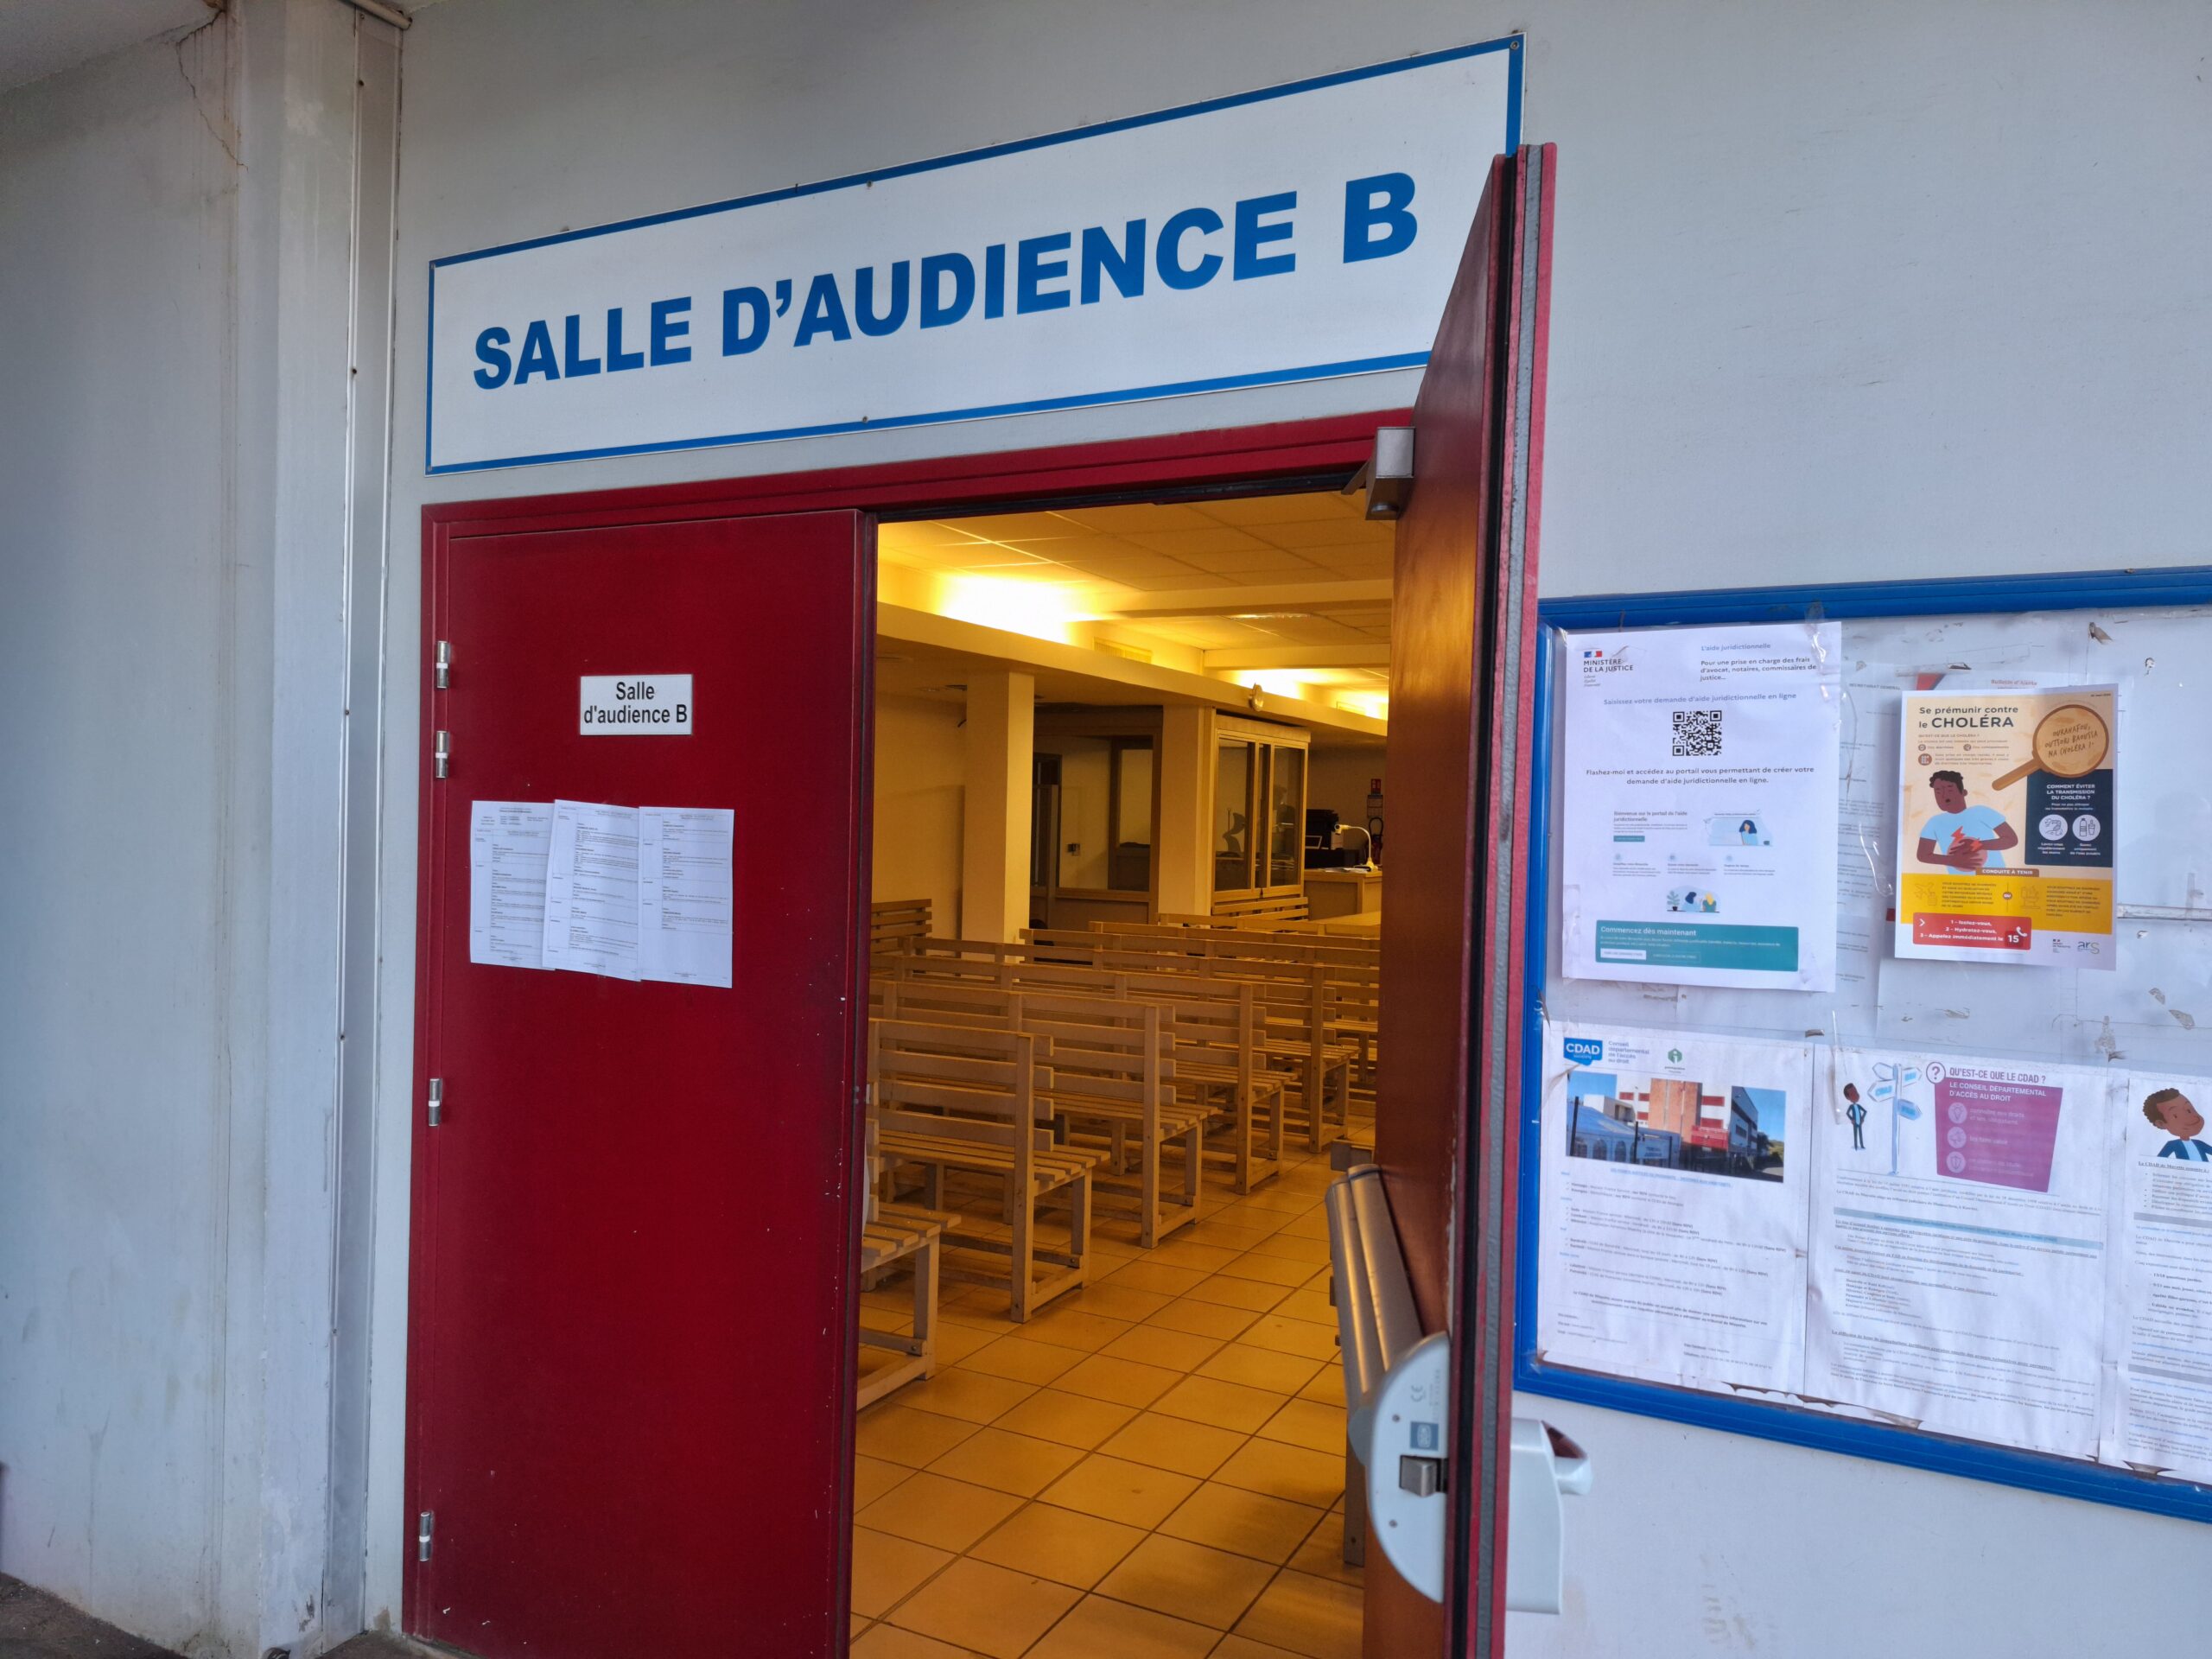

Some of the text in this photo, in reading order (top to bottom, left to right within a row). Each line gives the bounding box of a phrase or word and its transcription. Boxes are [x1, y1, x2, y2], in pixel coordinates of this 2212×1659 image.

[474, 172, 1418, 391] SALLE D'AUDIENCE B
[1720, 643, 1771, 652] juridictionnelle
[1605, 664, 1634, 673] JUSTICE
[616, 681, 655, 701] Salle
[1711, 693, 1766, 702] juridictionnelle
[583, 703, 688, 724] d'audience B
[1935, 706, 1982, 715] prémunir
[1932, 714, 2014, 728] CHOLÉRA
[1675, 767, 1699, 776] portail
[1719, 767, 1761, 776] permettant
[1657, 928, 1696, 937] maintenant
[2007, 935, 2019, 944] 15
[1566, 1043, 1600, 1055] CDAD
[1931, 1066, 1941, 1080] ?
[1949, 1067, 2046, 1084] QU'EST-CE QUE LE CDAD ?
[1960, 1082, 1987, 1091] CONSEIL
[1990, 1094, 2012, 1103] DROIT
